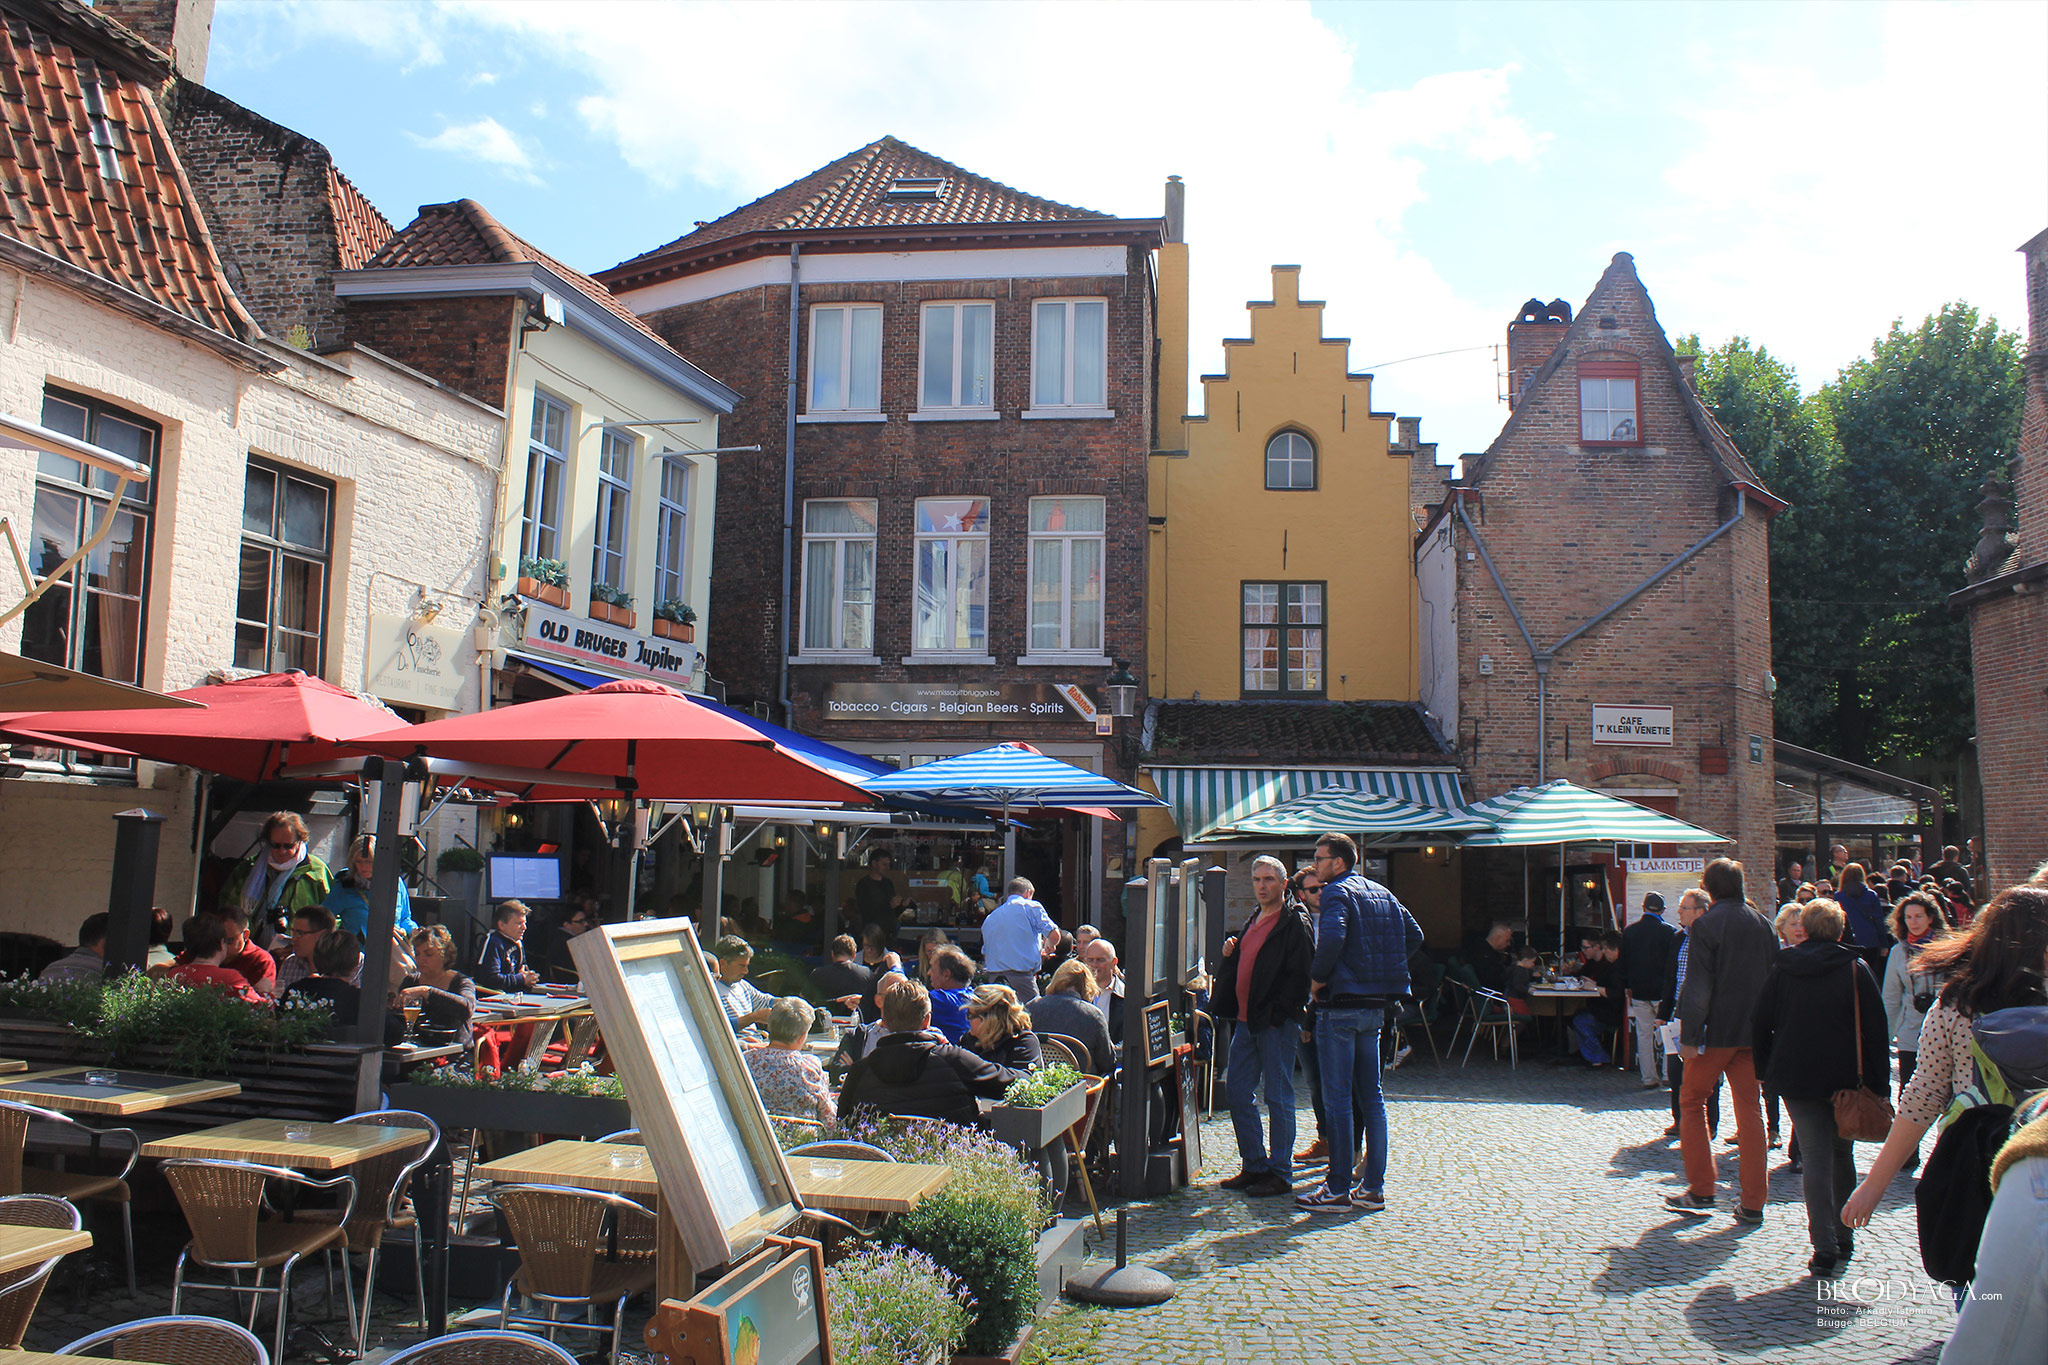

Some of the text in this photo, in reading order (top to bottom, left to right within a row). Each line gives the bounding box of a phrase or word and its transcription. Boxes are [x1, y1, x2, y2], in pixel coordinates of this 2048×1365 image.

[540, 619, 683, 672] OLD BRUGES Jupiler
[1066, 686, 1095, 716] Habanos
[828, 701, 880, 712] Tobacco
[890, 702, 928, 715] Cigars
[939, 702, 983, 715] Belgian
[986, 702, 1019, 713] Beers
[1029, 702, 1064, 715] Spirits
[1620, 716, 1643, 726] CAFE
[1595, 724, 1671, 736] 'T KLEIN VENETIE
[1640, 860, 1702, 873] LAMMETJE
